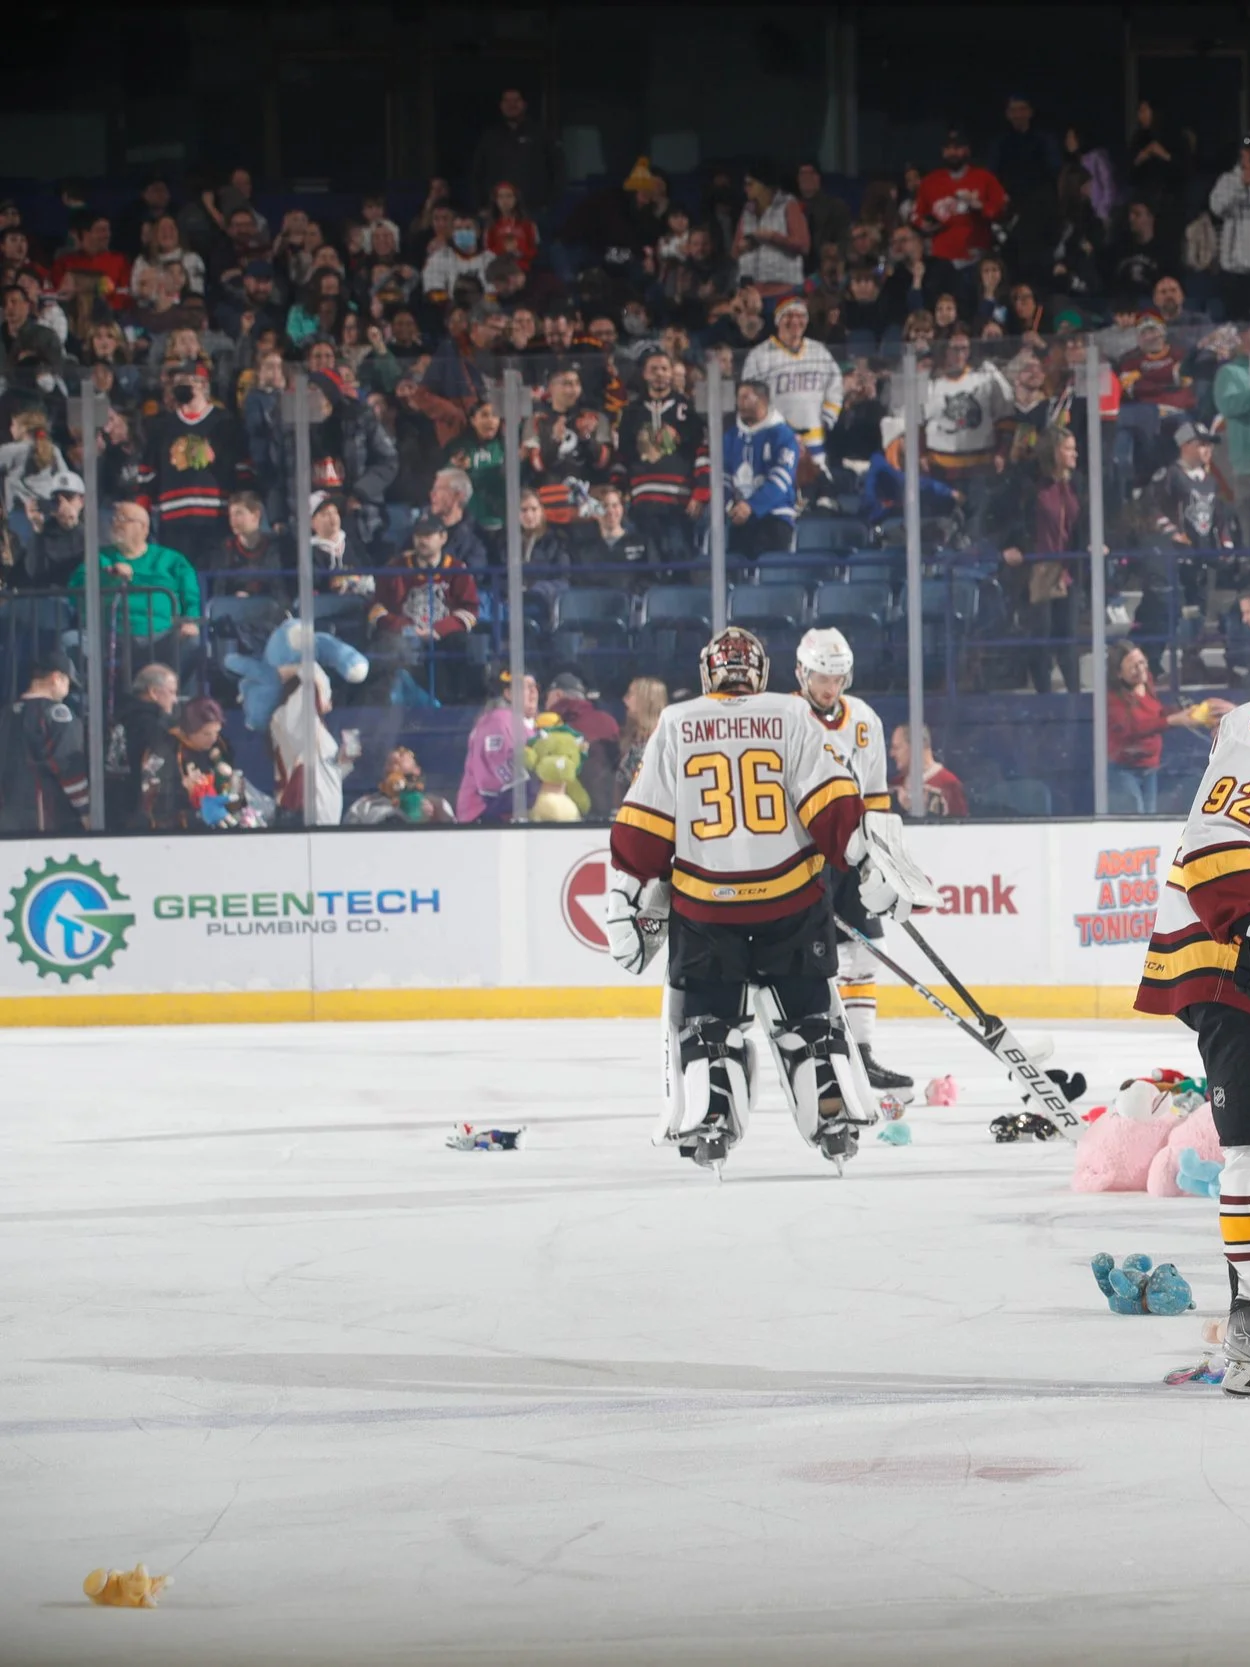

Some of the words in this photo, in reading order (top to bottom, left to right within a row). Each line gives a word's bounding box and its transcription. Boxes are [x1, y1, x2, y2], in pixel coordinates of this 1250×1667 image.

[681, 716, 783, 744] SAWCHENKO
[855, 721, 869, 749] C
[684, 747, 788, 841] 36
[1095, 846, 1161, 880] ADOPT
[153, 888, 440, 920] GREENTECH
[737, 887, 767, 896] CCM
[1098, 880, 1117, 909] A
[1119, 878, 1159, 908] DOG
[206, 919, 338, 937] PLUMBING
[346, 918, 389, 934] CO.
[914, 983, 962, 1024] CCM
